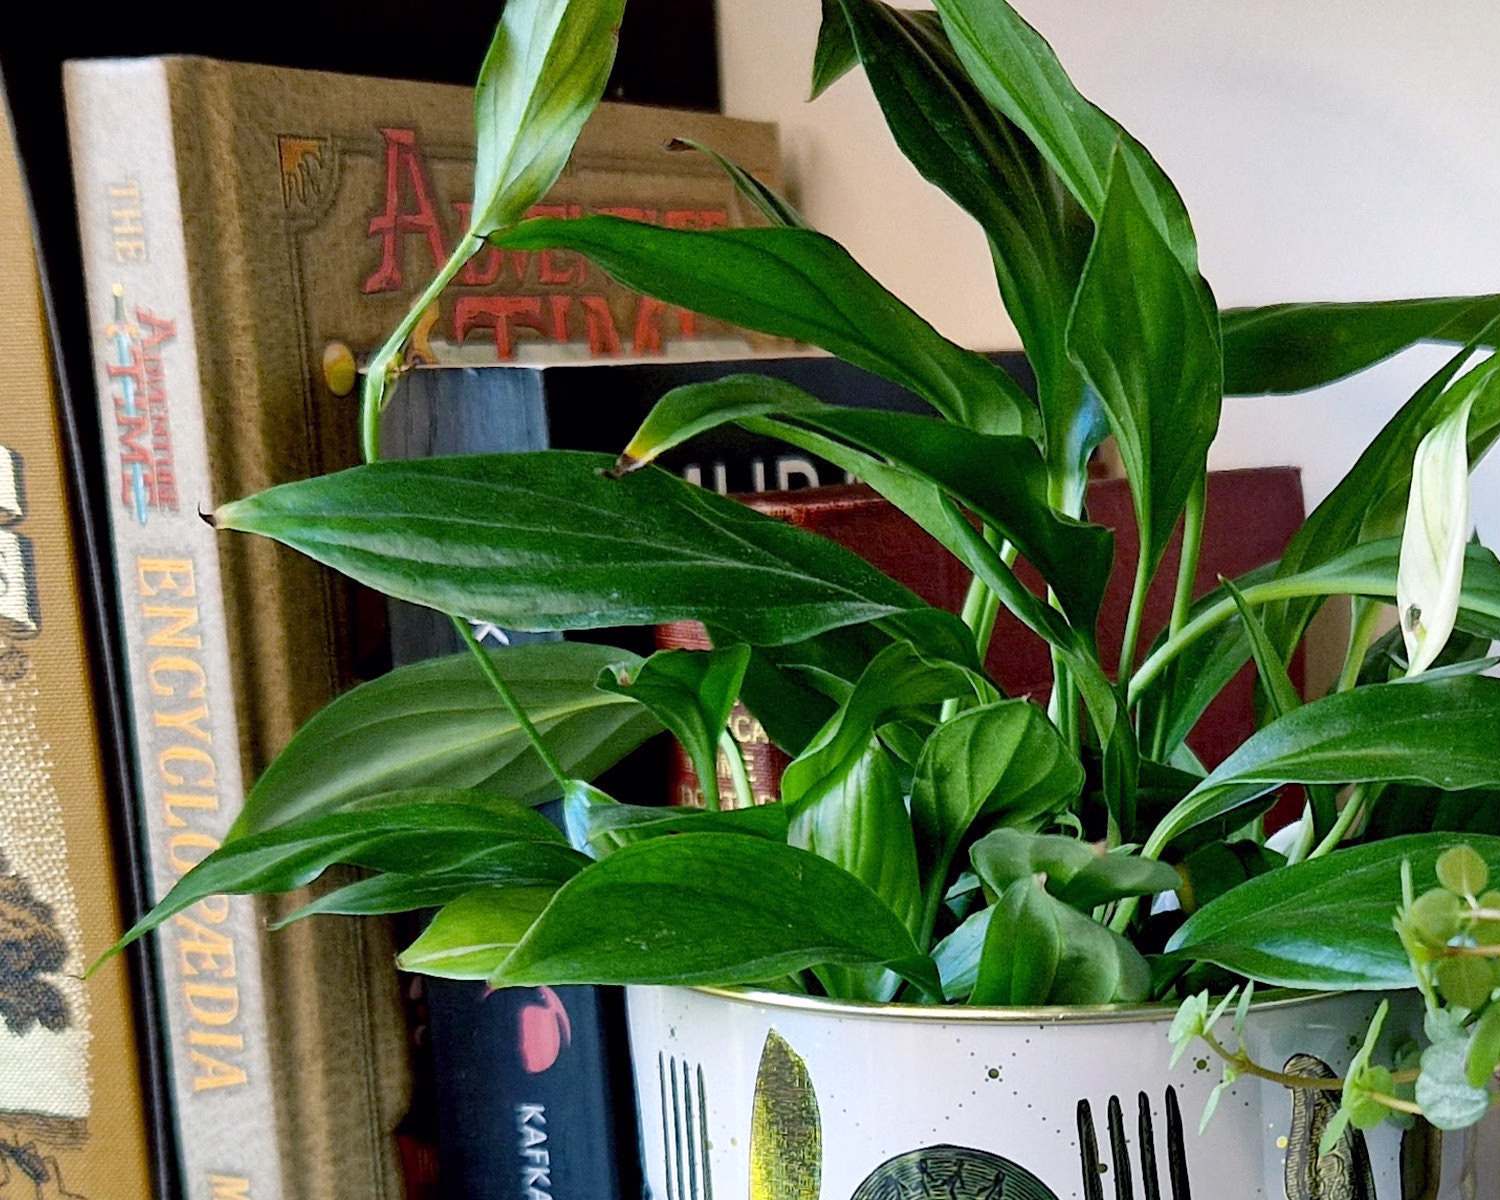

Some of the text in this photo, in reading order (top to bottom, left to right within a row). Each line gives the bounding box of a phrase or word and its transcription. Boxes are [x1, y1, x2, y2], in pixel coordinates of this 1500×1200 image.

[107, 180, 147, 264] THE
[107, 345, 160, 508] TIME
[137, 305, 180, 512] ADVENTURE
